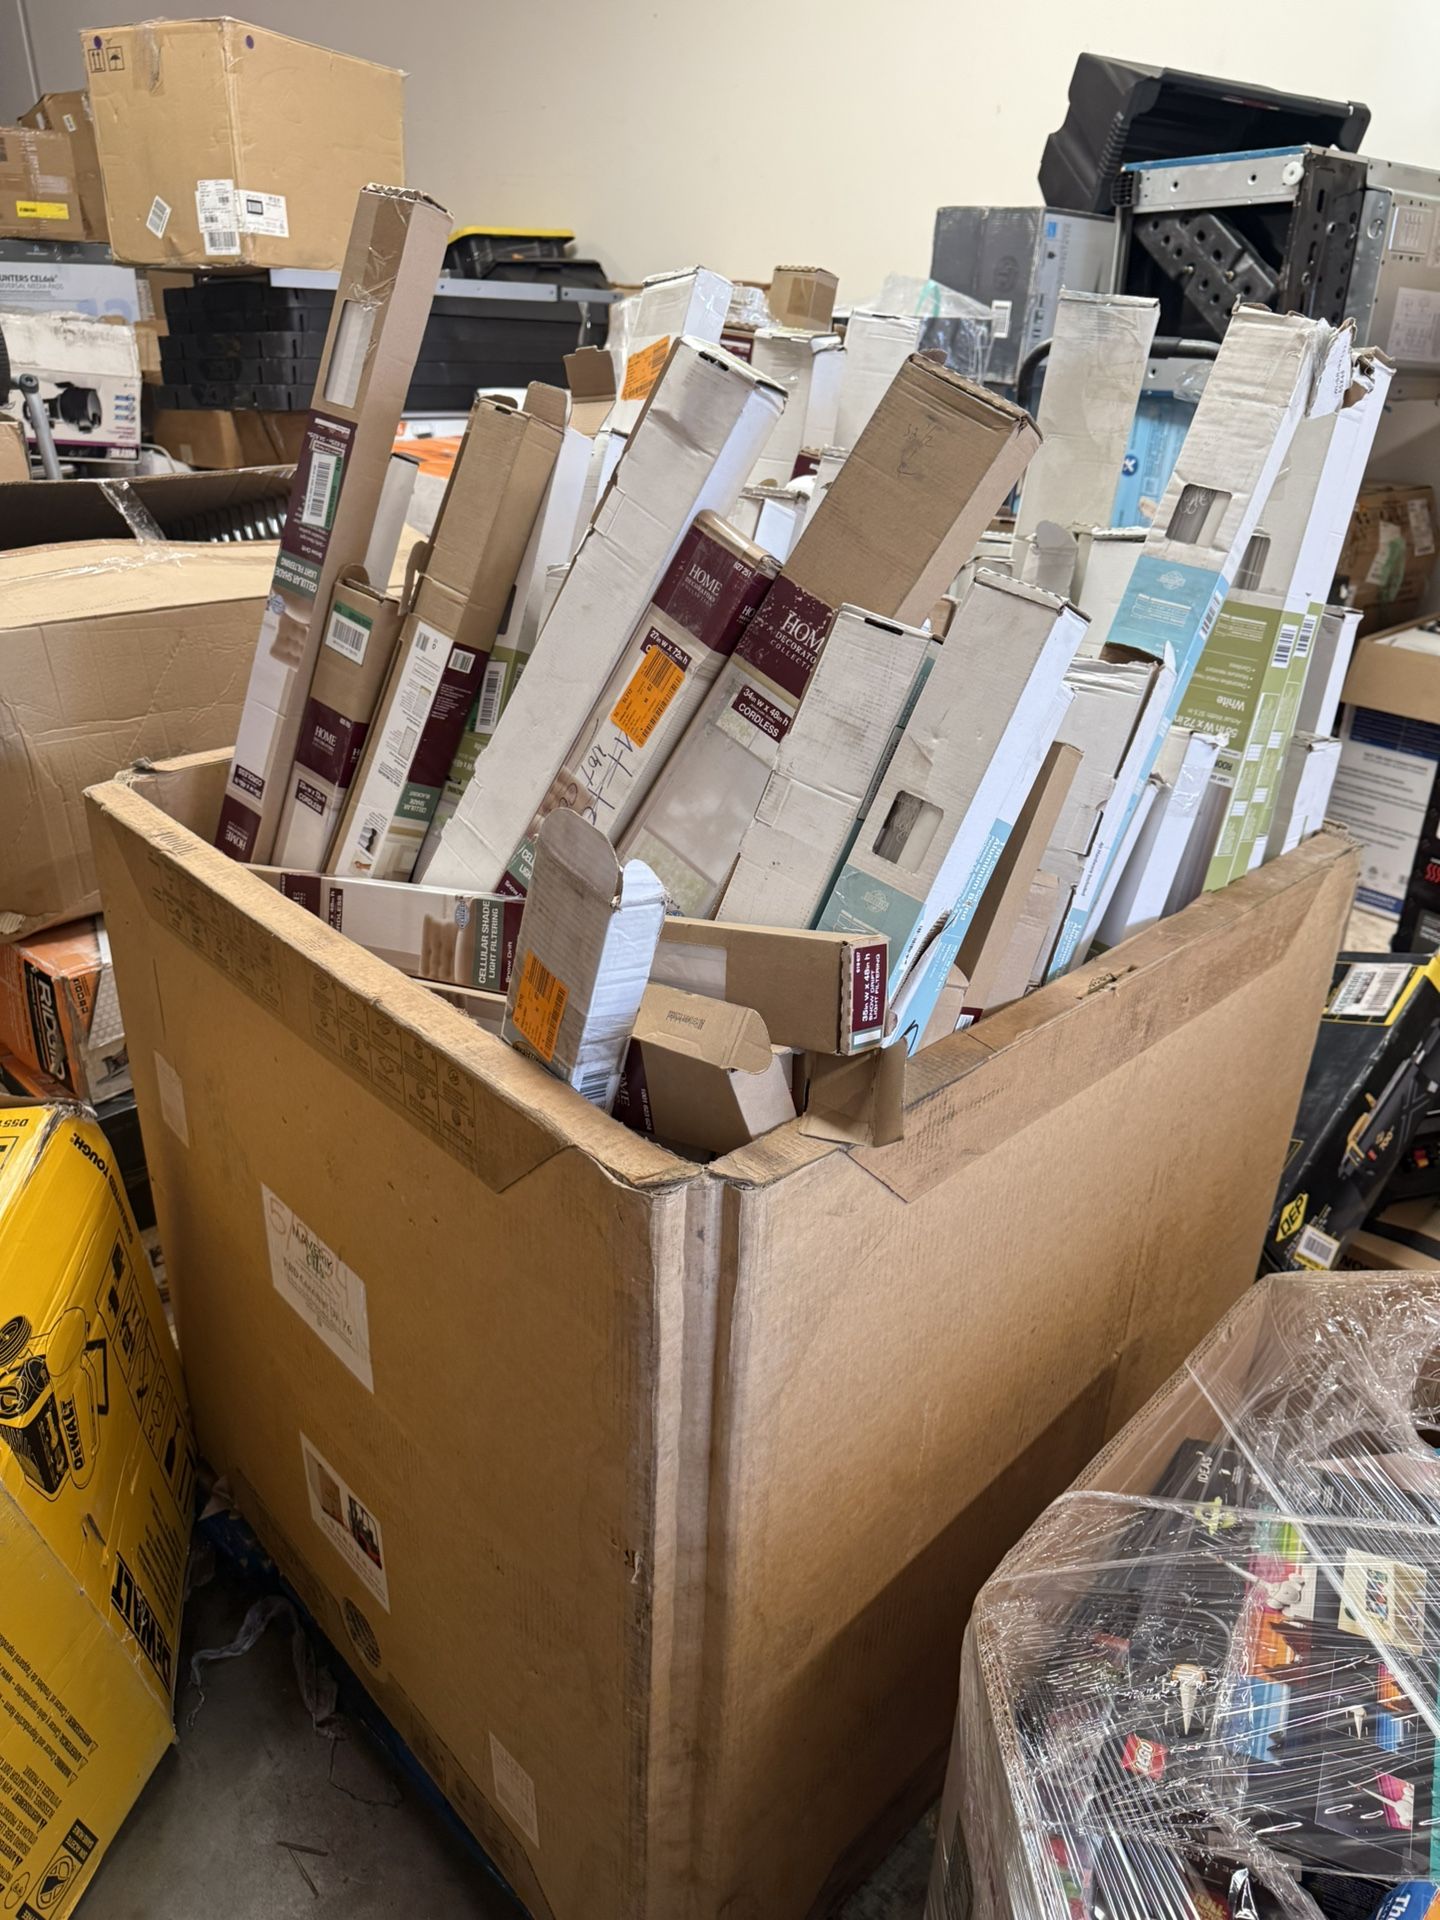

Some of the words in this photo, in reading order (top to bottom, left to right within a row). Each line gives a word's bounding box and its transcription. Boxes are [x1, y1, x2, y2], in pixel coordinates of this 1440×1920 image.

[272, 564, 293, 582] SHADE
[278, 556, 304, 574] FILTERING
[302, 565, 318, 579] LIGHT
[290, 572, 318, 592] CELLULAR
[681, 577, 718, 603] DECORATORS
[685, 563, 726, 596] HOME
[779, 612, 826, 653] HOM
[669, 647, 685, 661] 72in
[681, 656, 689, 665] h
[769, 638, 812, 672] COLLECTI
[774, 631, 817, 664] DECORATO
[741, 687, 759, 703] 34in
[755, 698, 765, 709] w
[762, 704, 770, 713] x
[767, 706, 785, 723] 48in
[780, 717, 790, 727] h
[1215, 694, 1245, 710] White
[736, 702, 780, 738] CORDLESS
[1182, 716, 1196, 728] 72
[1196, 719, 1204, 728] x
[1202, 720, 1215, 732] W
[315, 725, 337, 747] HOME
[237, 767, 262, 785] CORDLESS
[297, 792, 321, 812] CORDLESS
[403, 803, 426, 814] CELLULAR
[224, 829, 246, 850] HOME
[519, 863, 532, 880] LIGH
[970, 837, 1001, 891] Aluminum
[1088, 849, 1101, 873] Hardware
[979, 860, 995, 888] Custom
[1080, 874, 1092, 896] Included
[972, 888, 982, 903] Cut
[482, 900, 490, 934] SHADE
[490, 908, 499, 956] FILTERING
[479, 936, 489, 984] CELLULAR
[620, 1071, 630, 1105] OME
[60, 1398, 84, 1470] DEWALT
[1197, 1455, 1212, 1483] IDEAS
[110, 1558, 171, 1687] DEWALT
[33, 1678, 52, 1699] Troubles
[2, 1700, 16, 1715] Harm
[11, 1711, 40, 1741] Reproductive
[66, 1715, 93, 1746] AVERTISSEMENT
[41, 1744, 57, 1760] Cancer
[1134, 1740, 1154, 1771] LEGO
